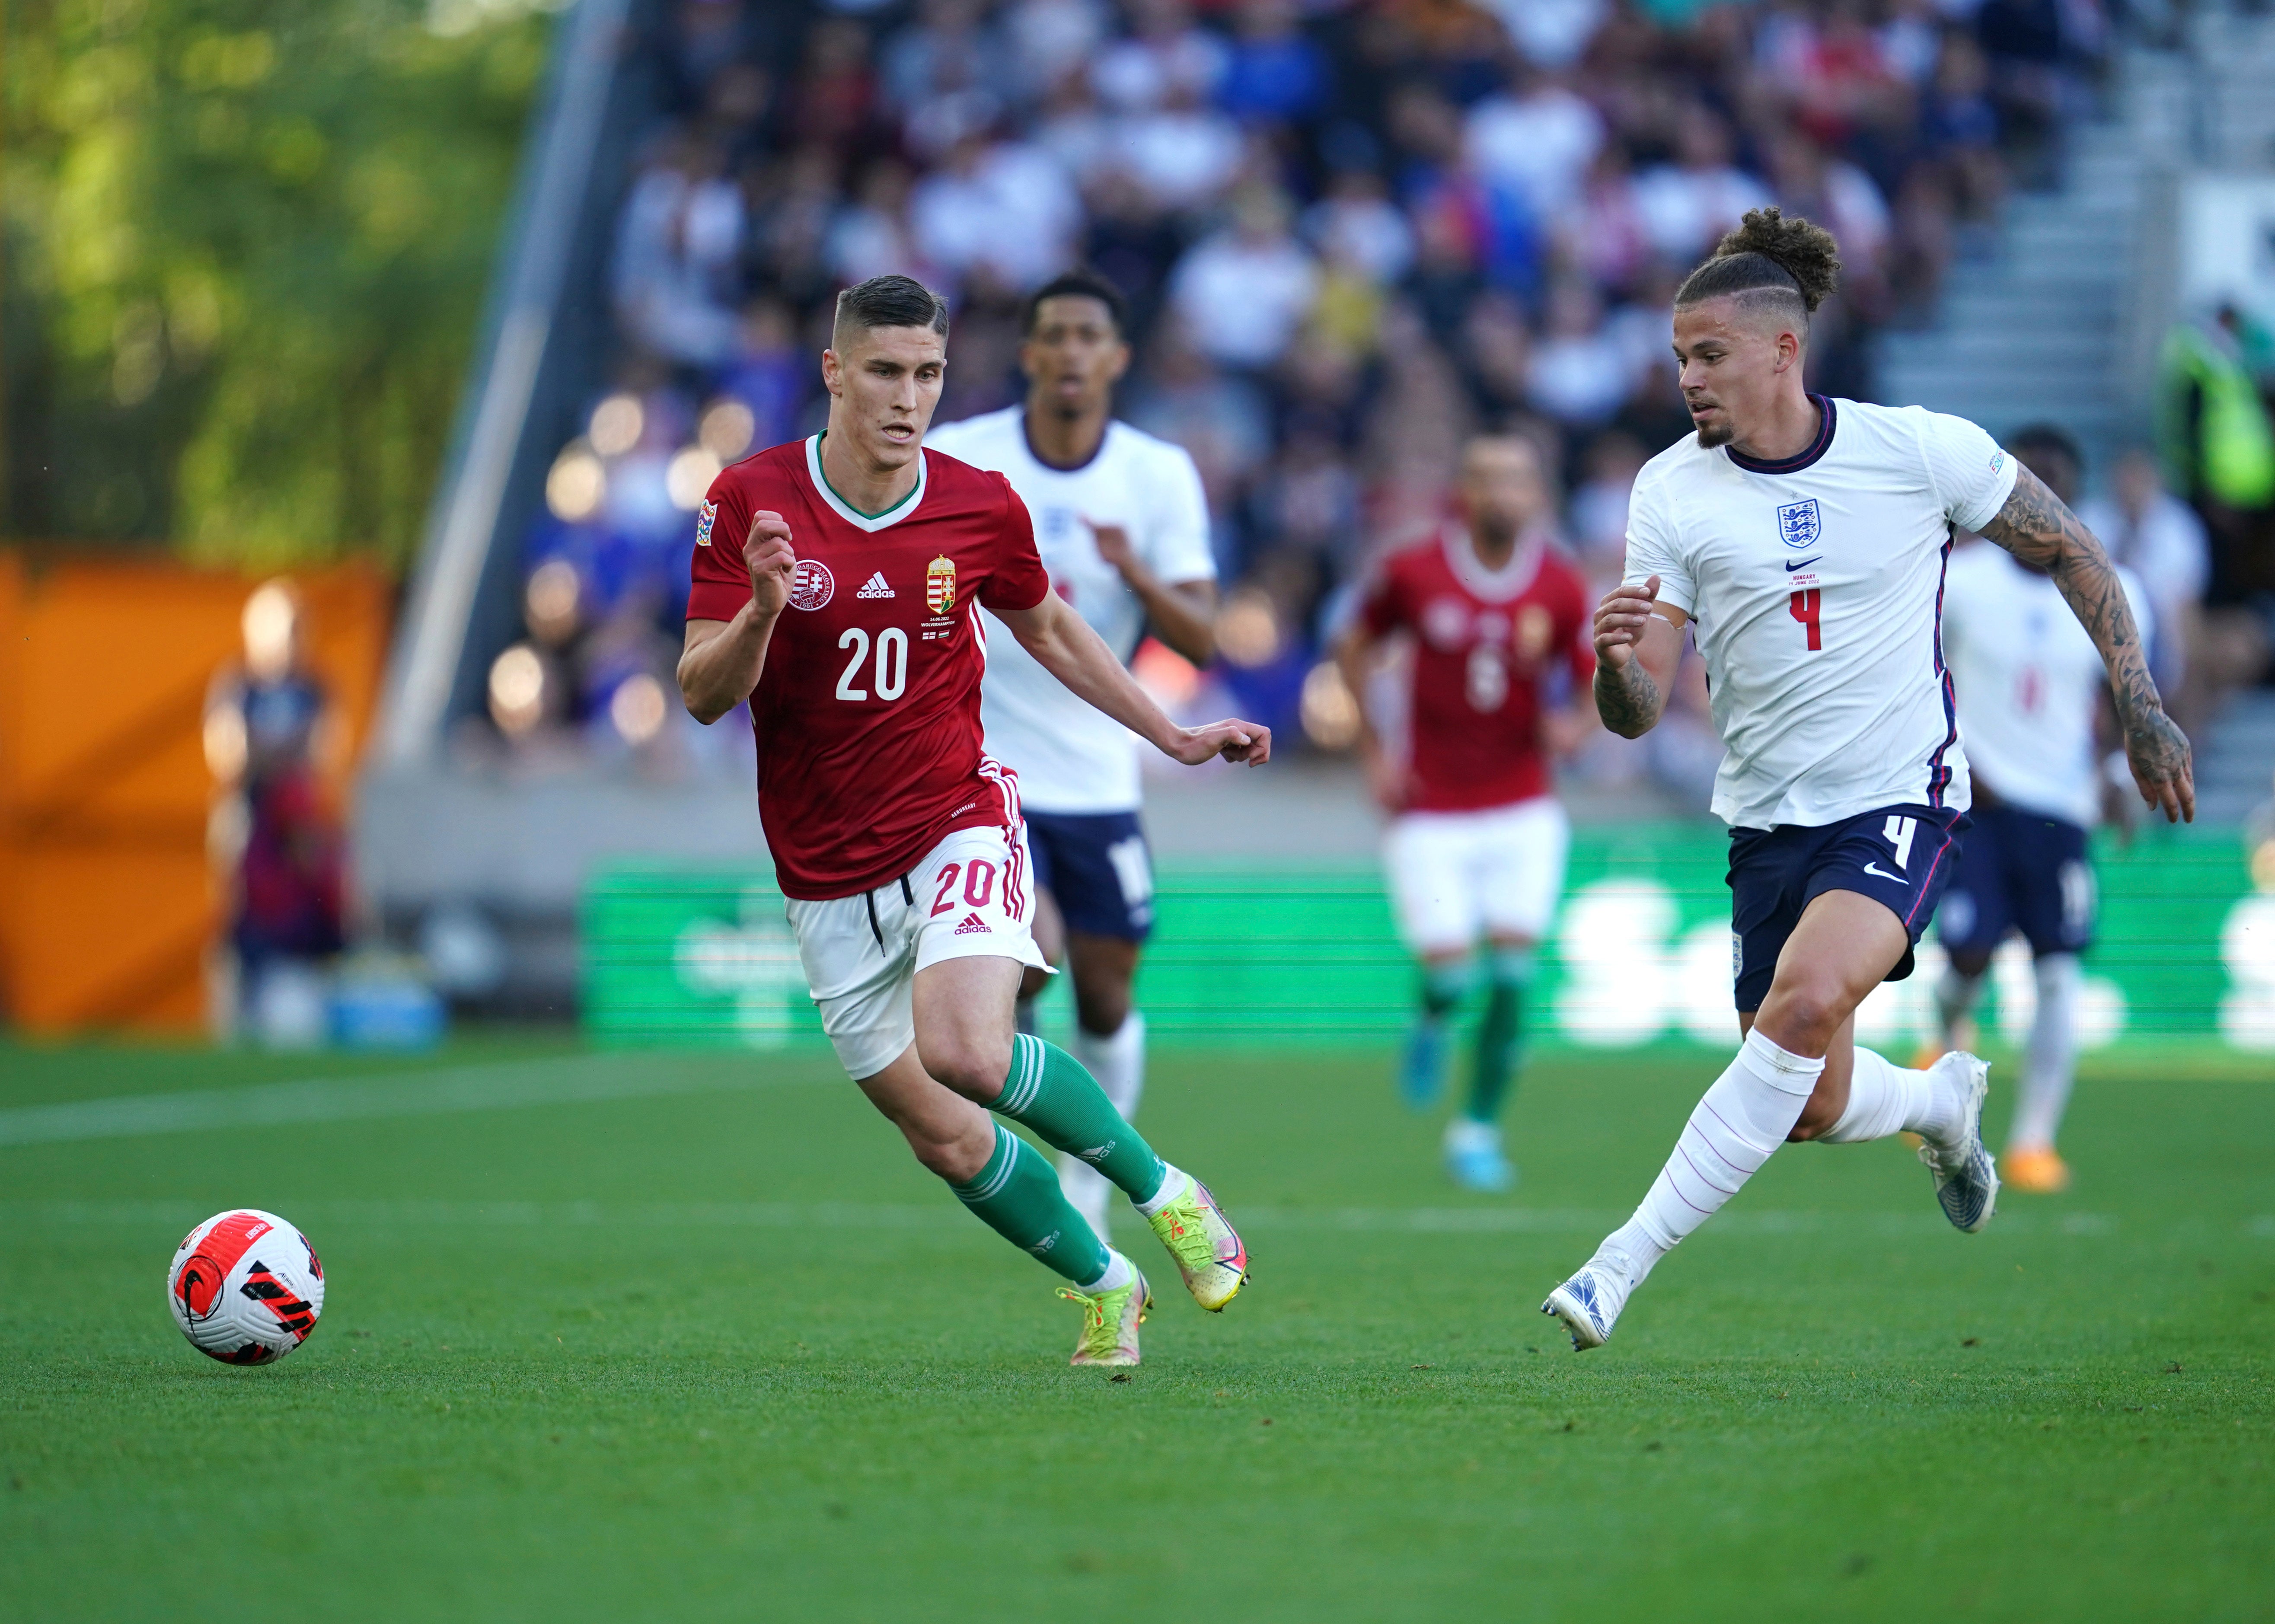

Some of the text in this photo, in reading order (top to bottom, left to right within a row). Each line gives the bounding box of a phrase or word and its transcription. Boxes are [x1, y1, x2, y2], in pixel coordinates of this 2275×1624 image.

[856, 589, 895, 599] adidas
[1790, 589, 1821, 651] 4
[836, 627, 908, 701] 20
[951, 802, 976, 818] AEROREADY
[1882, 815, 1918, 870] 4
[930, 859, 996, 918] 20
[954, 925, 992, 935] adidas
